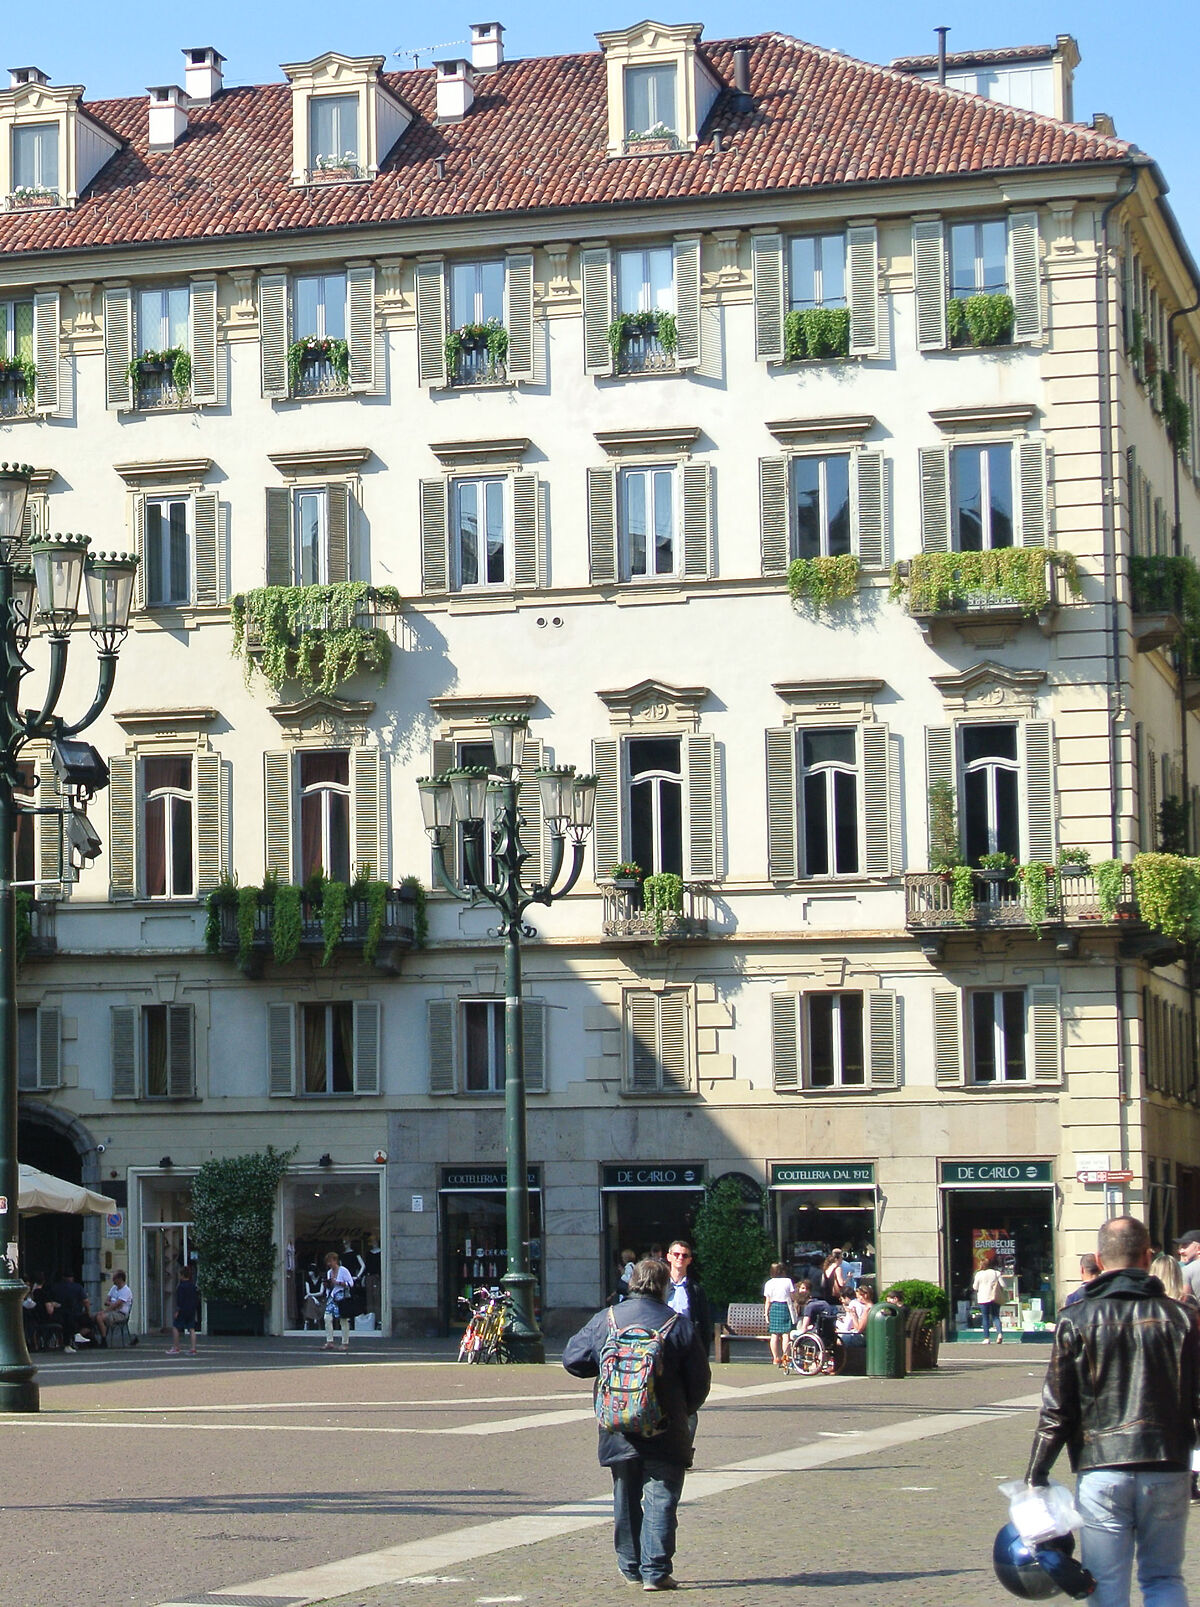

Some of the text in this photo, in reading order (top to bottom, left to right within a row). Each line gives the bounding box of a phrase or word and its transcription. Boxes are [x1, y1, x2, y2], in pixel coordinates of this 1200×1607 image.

[617, 1170, 676, 1183] DE CARLO
[778, 1170, 869, 1180] COLTELLERIA DAL 1912
[958, 1166, 1020, 1179] DE CARLO
[448, 1174, 498, 1184] COLTELLERIA
[975, 1239, 1016, 1248] BARBECUE
